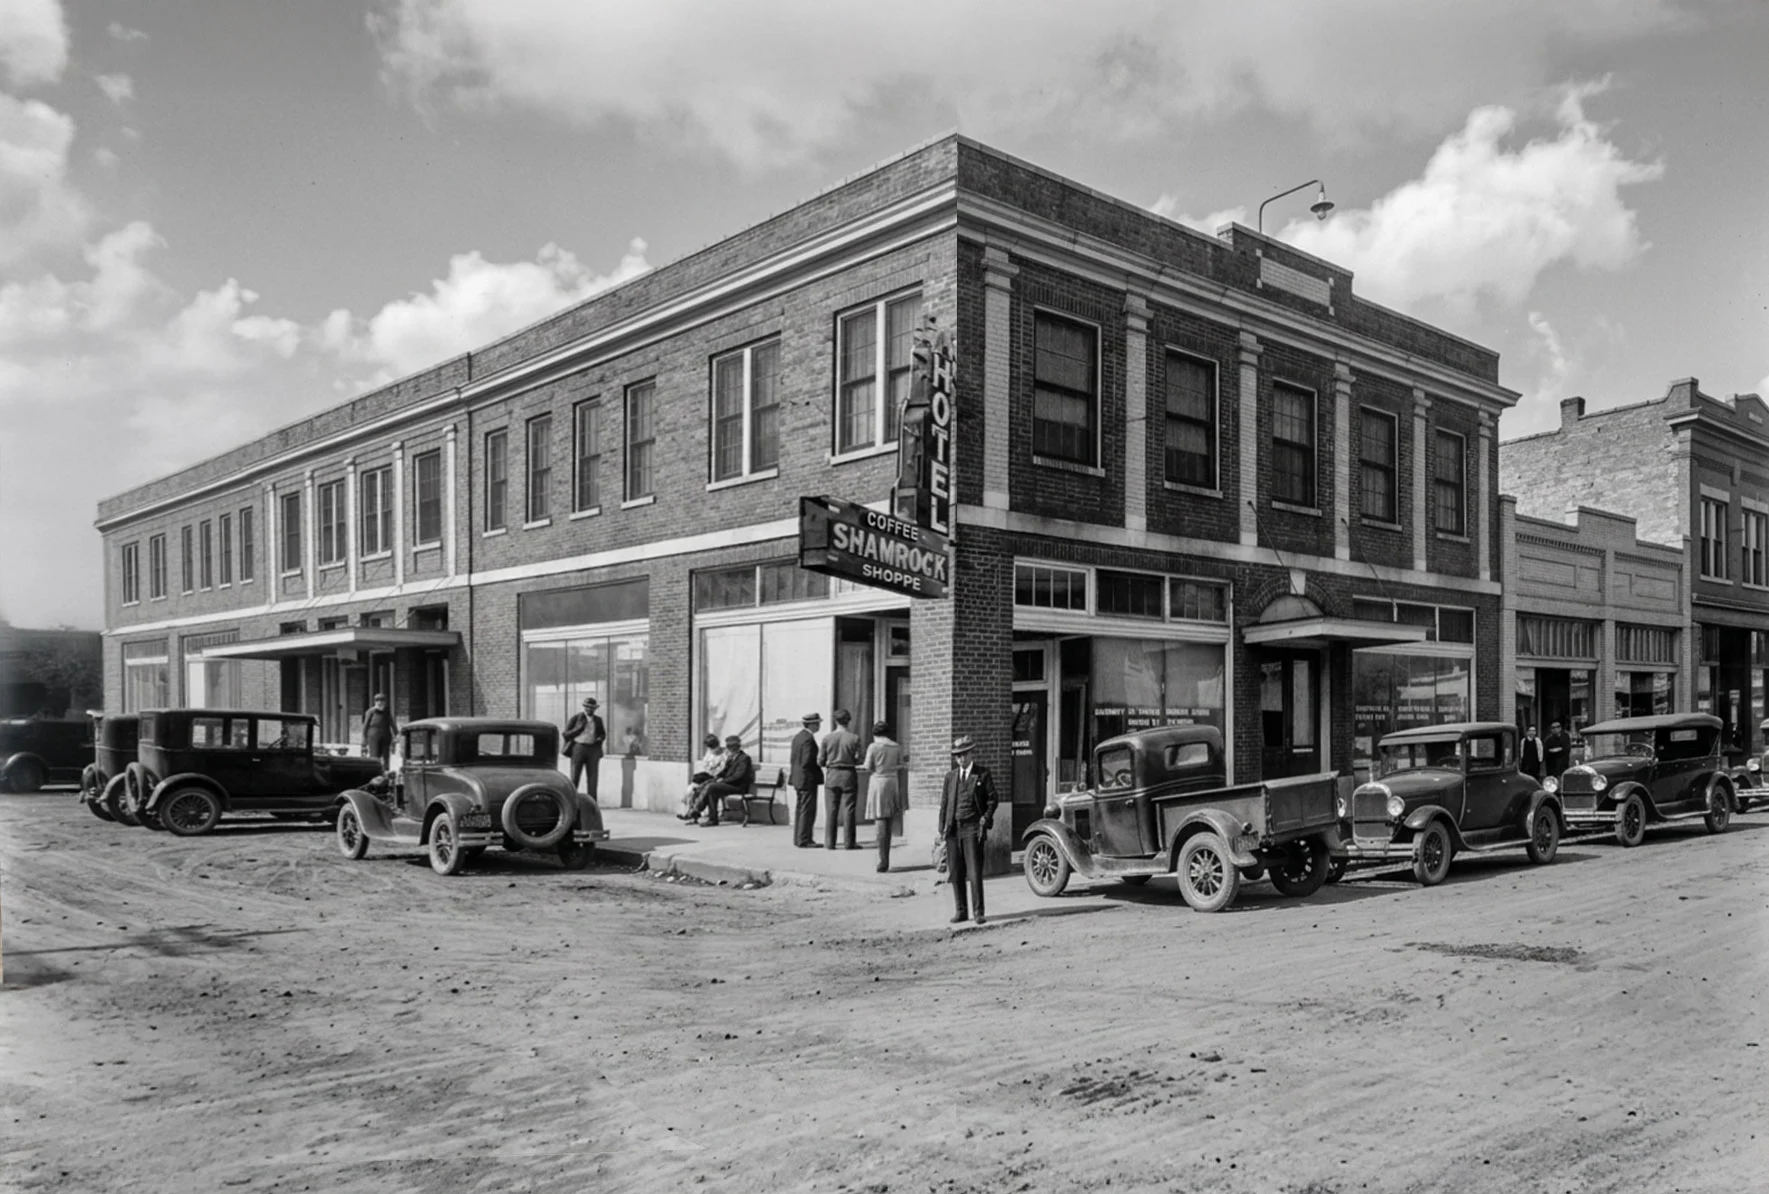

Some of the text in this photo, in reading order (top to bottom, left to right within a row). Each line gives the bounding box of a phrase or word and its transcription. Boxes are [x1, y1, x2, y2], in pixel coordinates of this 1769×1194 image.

[930, 353, 950, 535] HOTEL
[867, 511, 919, 541] COFFEE
[833, 522, 946, 582] SHAMROCK
[862, 564, 921, 592] SHOPPE
